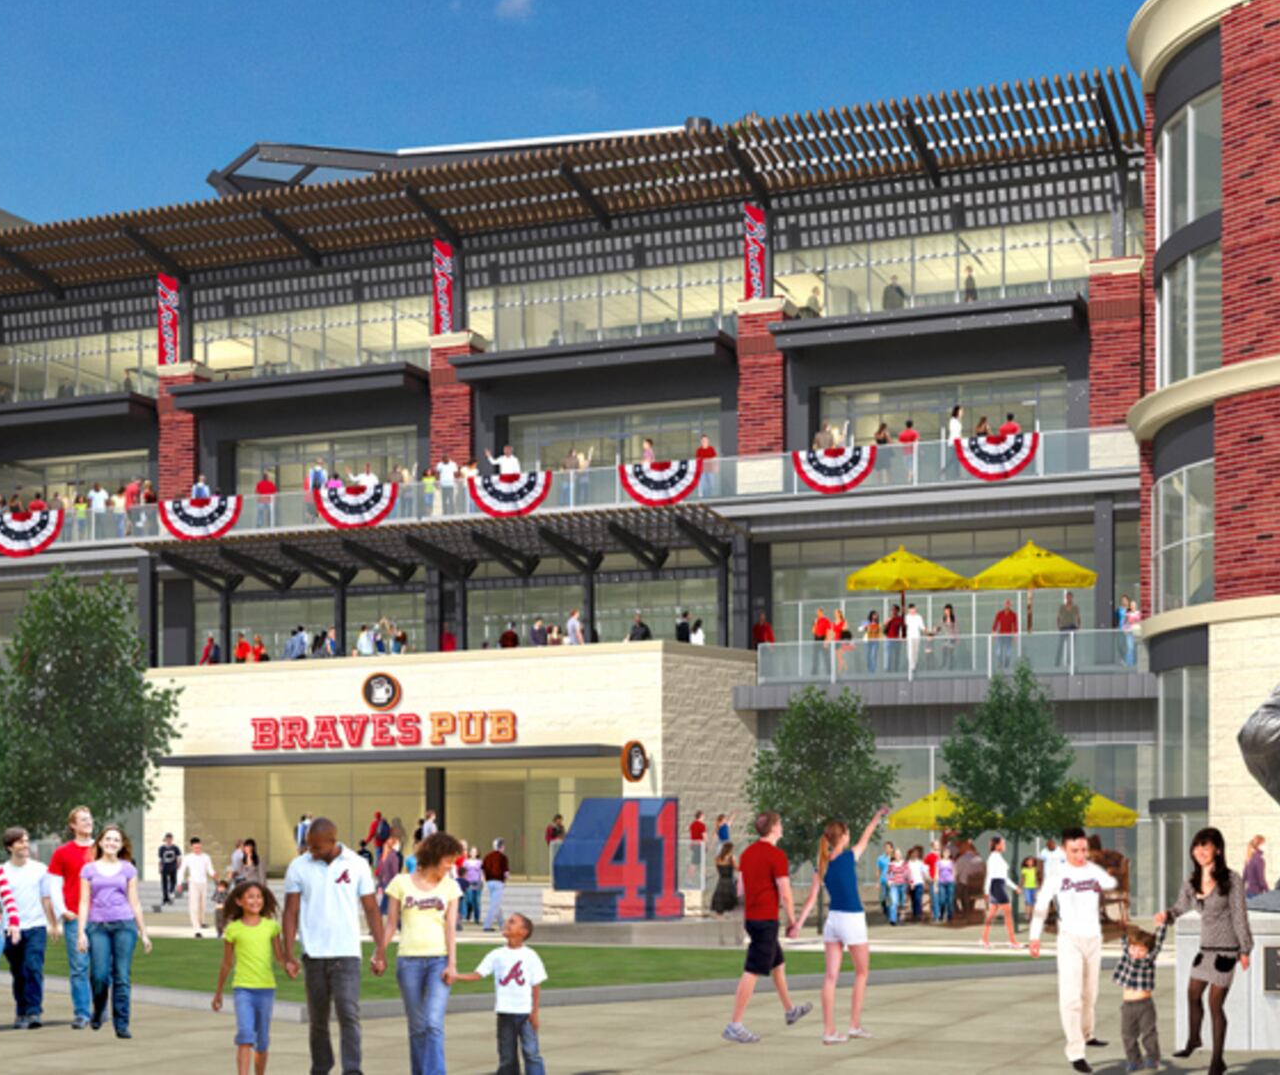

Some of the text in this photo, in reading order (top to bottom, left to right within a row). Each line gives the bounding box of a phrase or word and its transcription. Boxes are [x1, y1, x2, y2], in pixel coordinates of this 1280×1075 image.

[251, 709, 518, 751] BRAVES PUB
[594, 799, 685, 919] 41
[499, 960, 525, 986] A
